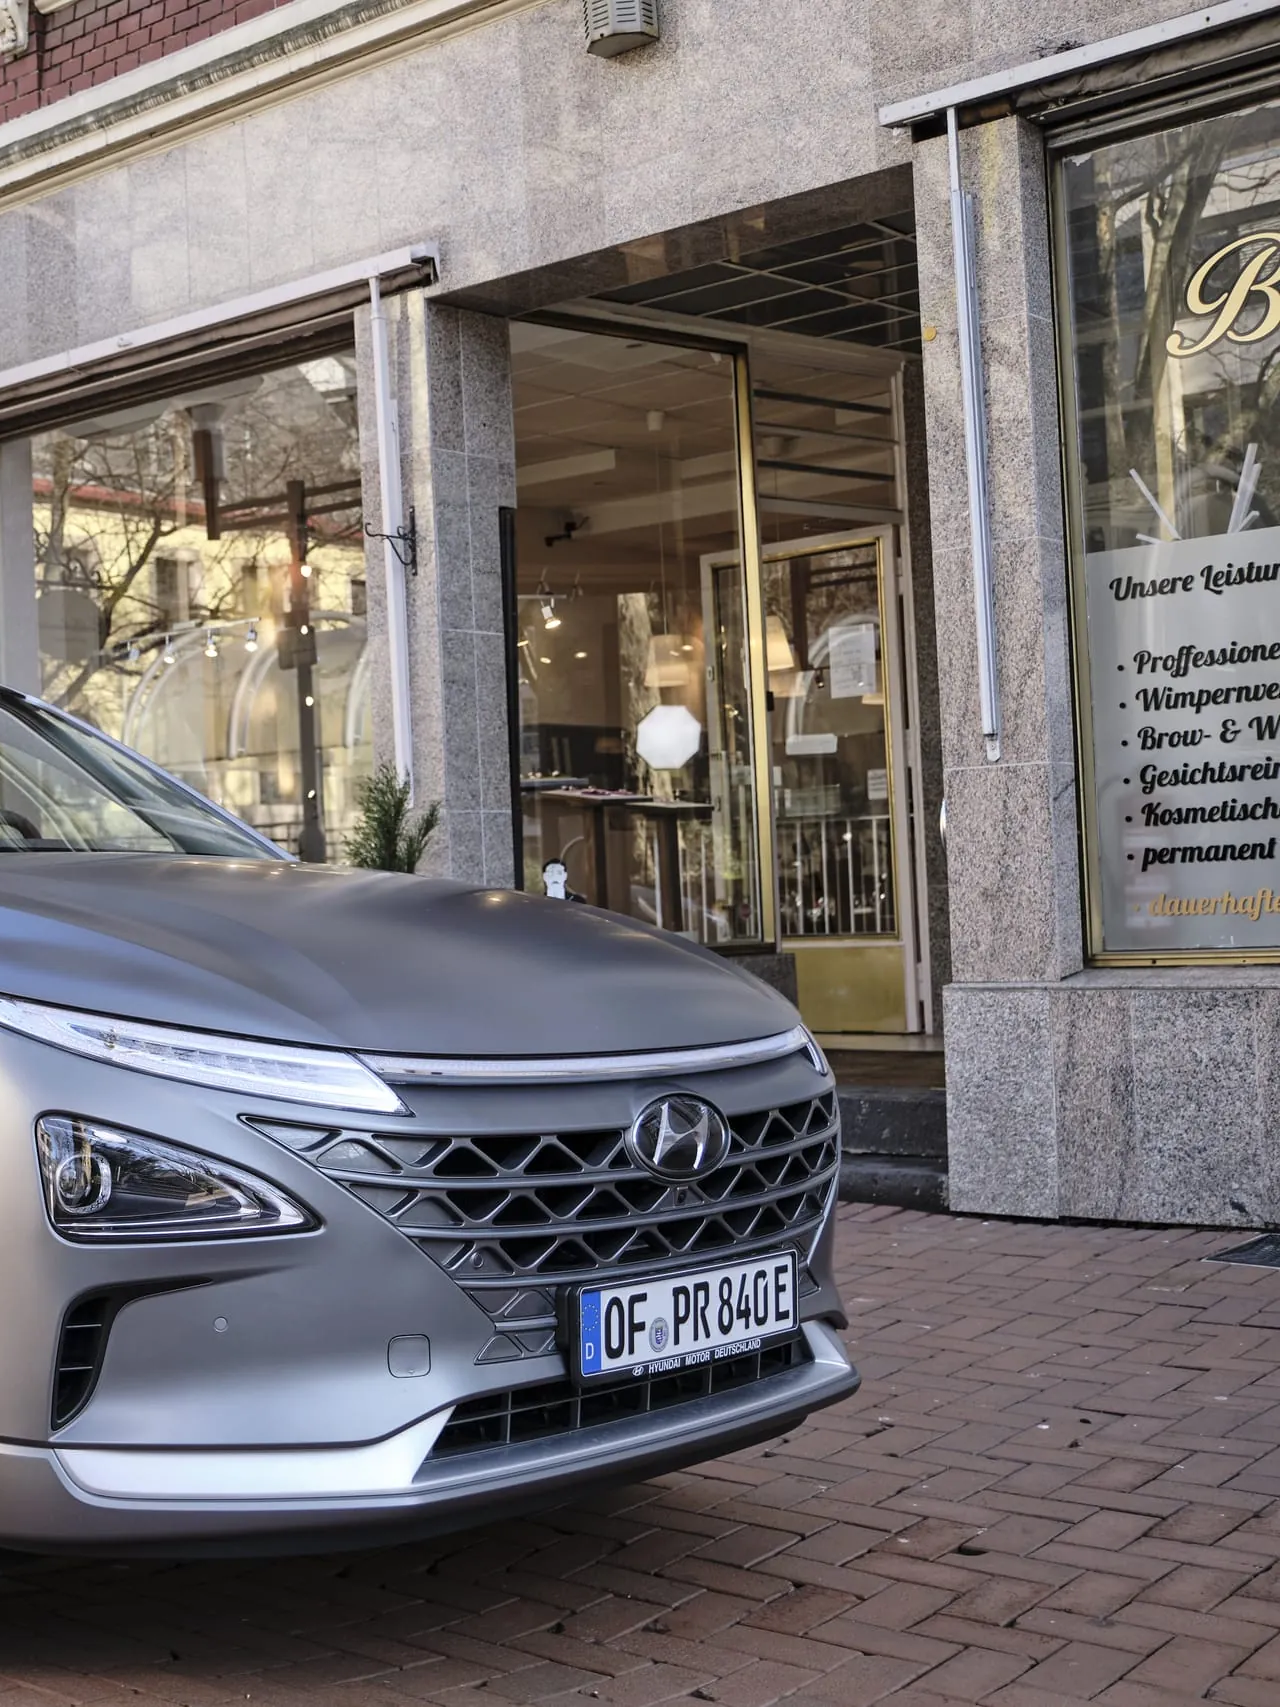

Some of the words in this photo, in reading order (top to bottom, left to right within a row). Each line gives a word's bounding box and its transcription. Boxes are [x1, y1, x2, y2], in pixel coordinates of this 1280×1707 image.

[1109, 574, 1195, 601] Unsere
[1133, 641, 1280, 678] Proffessione
[1135, 683, 1280, 714] Wimpernve
[1138, 725, 1211, 750] Brow-
[1219, 719, 1242, 744] &
[1141, 796, 1280, 828] Kosmetisch
[1141, 837, 1277, 872] permanent
[604, 1292, 648, 1359] OF
[672, 1281, 710, 1346] PR
[585, 1342, 595, 1360] D
[648, 1358, 681, 1374] HYUNDAI
[685, 1351, 711, 1366] MOTOR
[714, 1338, 761, 1359] DEUTSCHLAND
